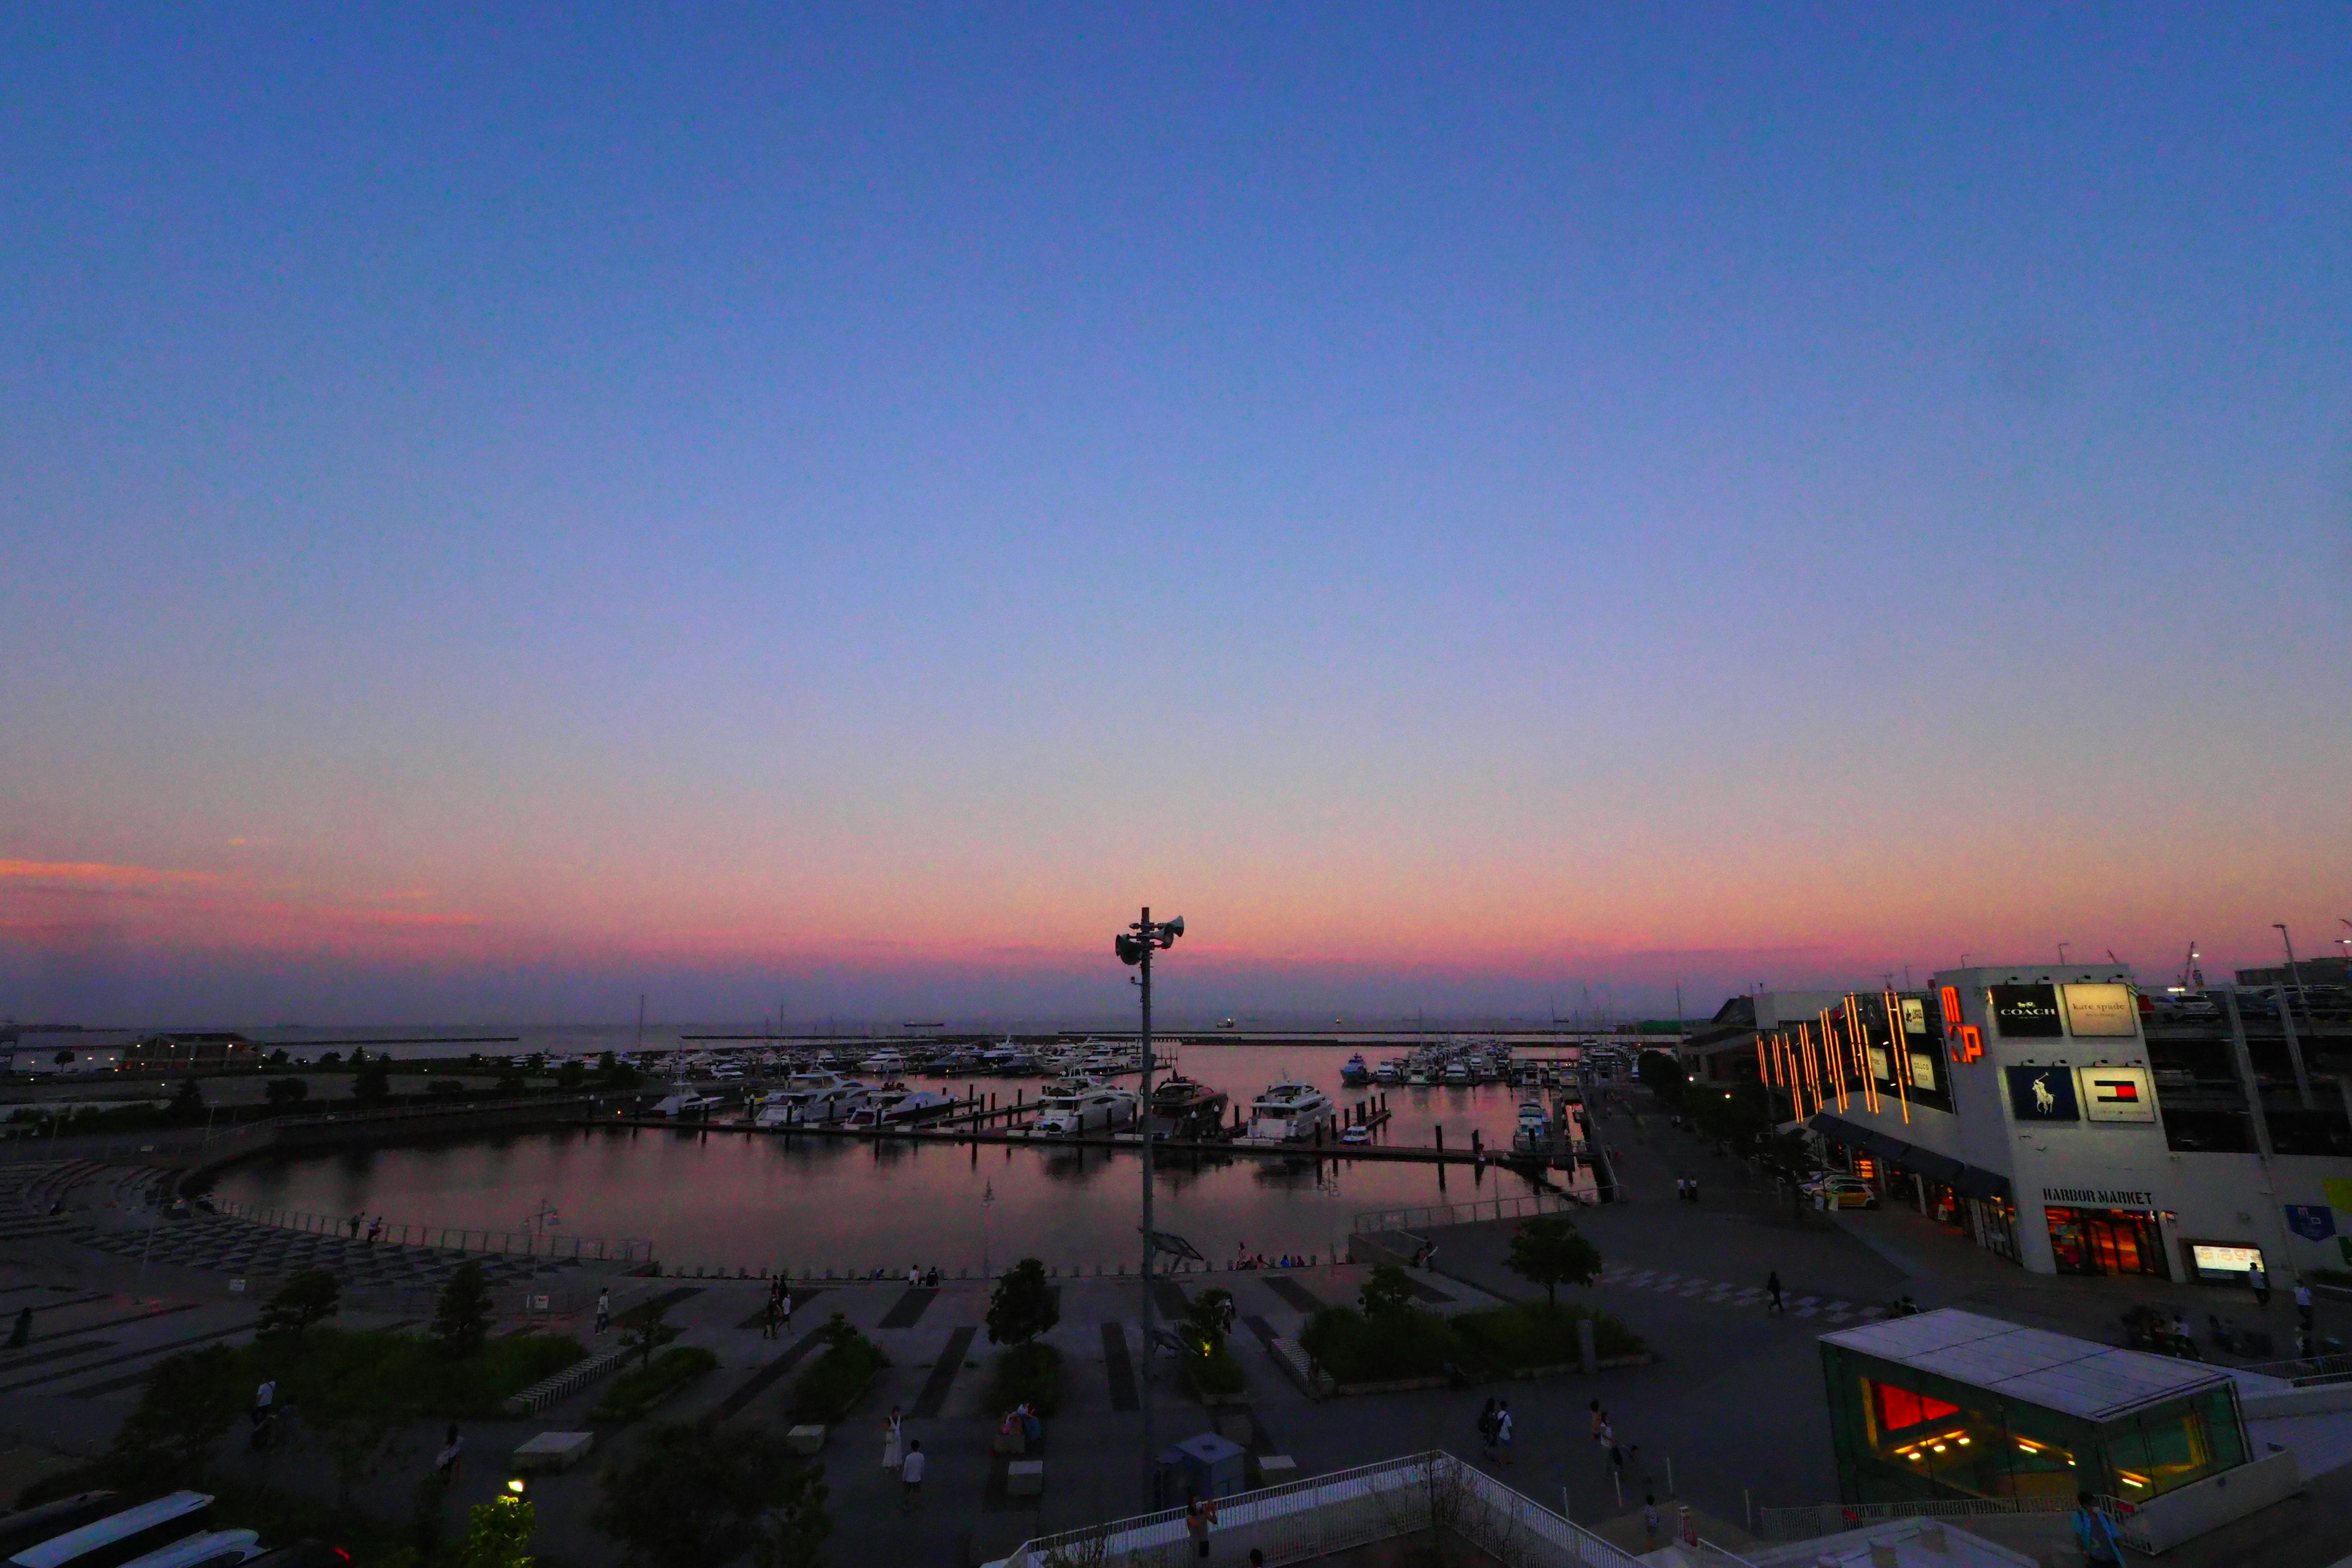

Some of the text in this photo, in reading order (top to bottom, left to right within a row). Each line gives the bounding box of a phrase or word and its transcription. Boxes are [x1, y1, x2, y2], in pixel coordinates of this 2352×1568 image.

[2097, 1003, 2125, 1012] spade
[2043, 1188, 2152, 1205] HARBOR MARKET
